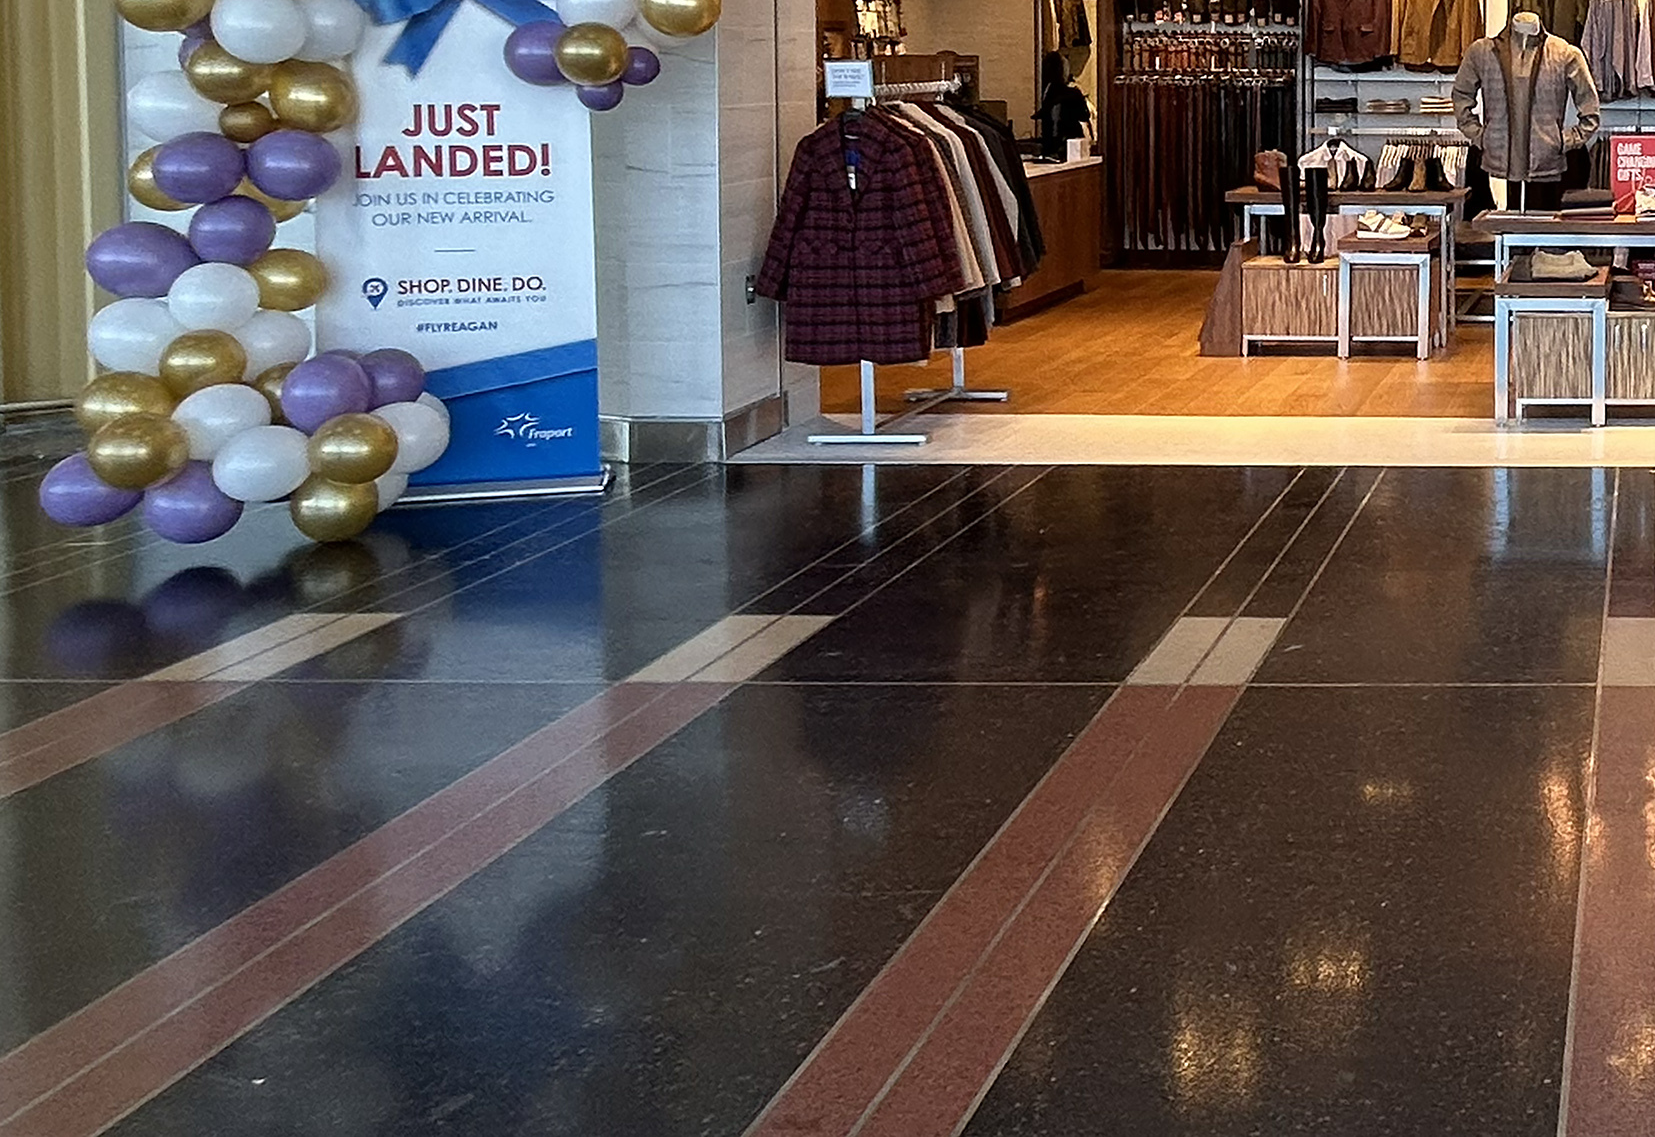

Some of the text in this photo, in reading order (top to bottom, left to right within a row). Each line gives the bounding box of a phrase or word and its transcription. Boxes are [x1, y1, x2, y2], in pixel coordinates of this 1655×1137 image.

[401, 103, 501, 137] JUST
[355, 143, 551, 179] LANDED!
[352, 189, 555, 208] JOIN US IN CELEBRATING
[371, 210, 533, 227] OUR NEW ARRIVAL.
[397, 276, 547, 295] SHOP. DINE. DO.
[415, 321, 498, 333] #FLYREAGAN
